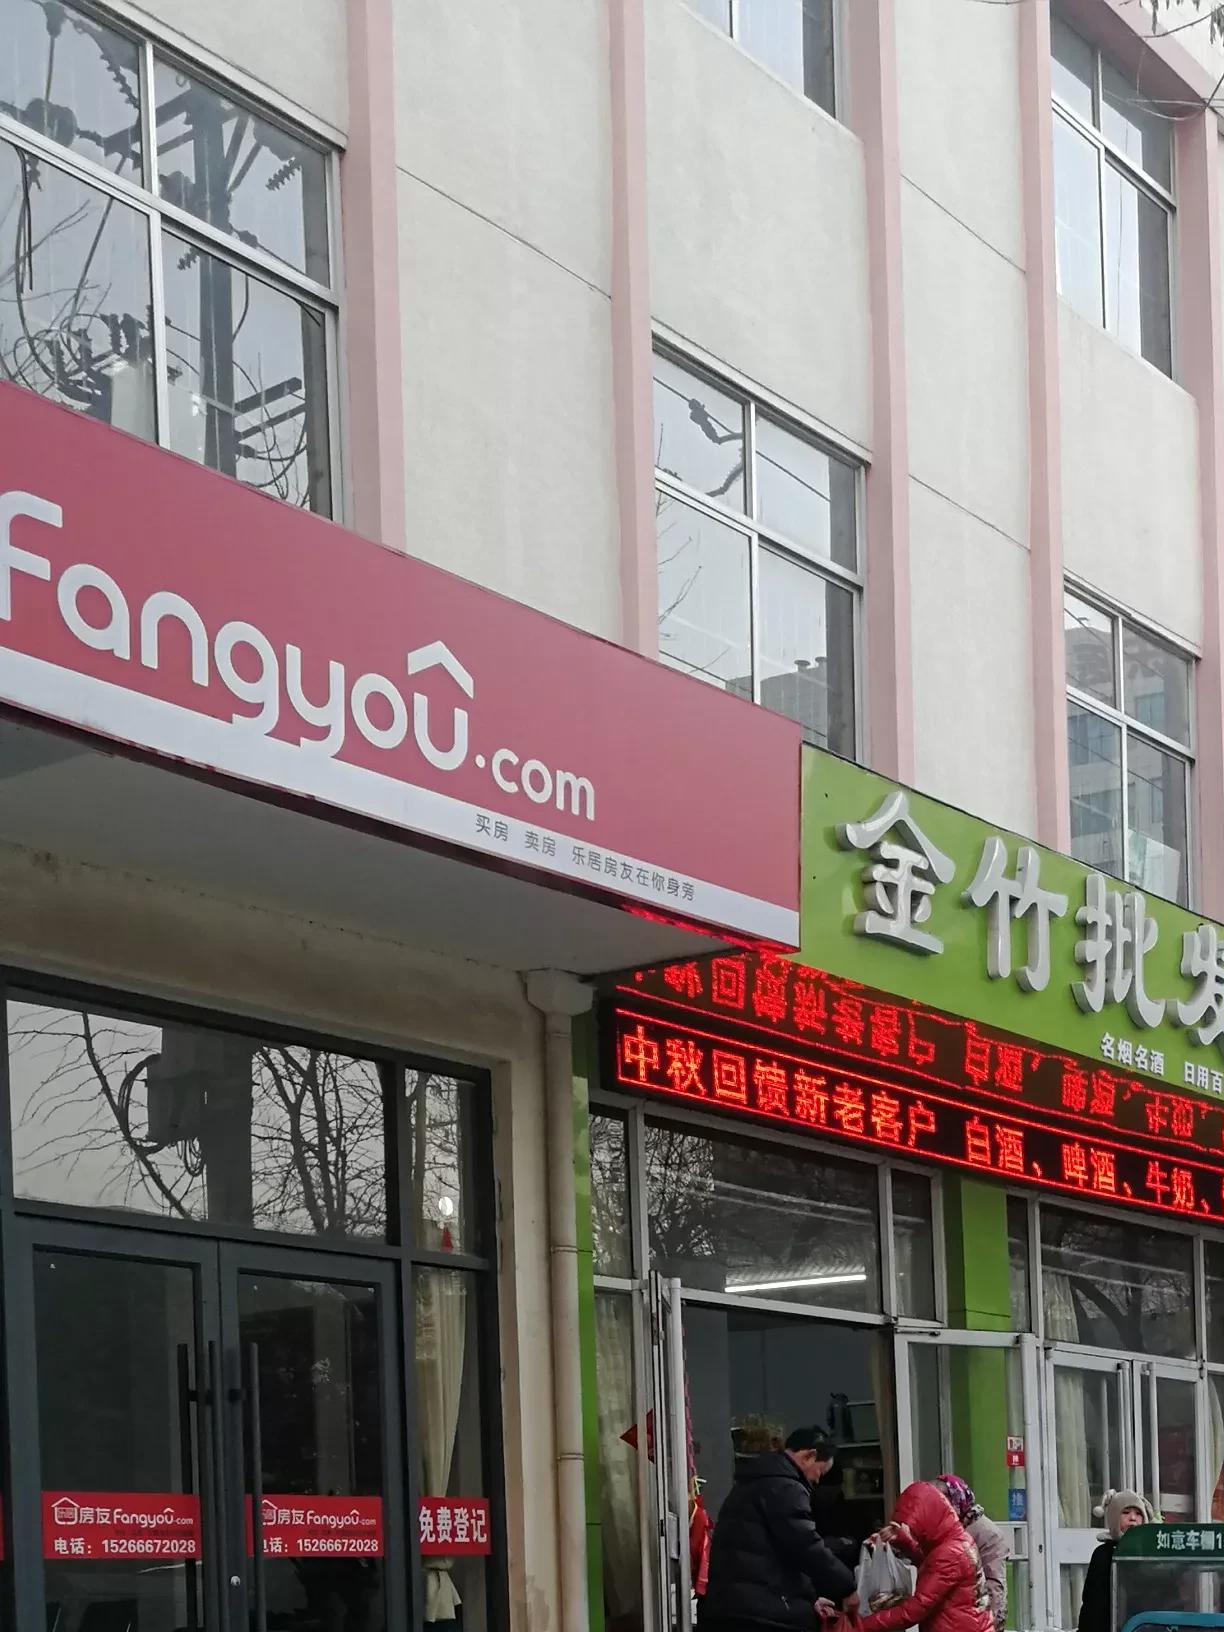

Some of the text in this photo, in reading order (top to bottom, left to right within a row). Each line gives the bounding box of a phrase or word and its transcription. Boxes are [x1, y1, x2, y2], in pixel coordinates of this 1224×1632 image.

[476, 813, 696, 901] 买房 卖房 乐居房友在你身旁
[1101, 1032, 1165, 1076] 名烟名酒
[623, 1024, 936, 1148] 中秋回馈新老客户
[263, 1537, 379, 1553] 话：15266672028
[419, 1506, 488, 1544] 免费登记
